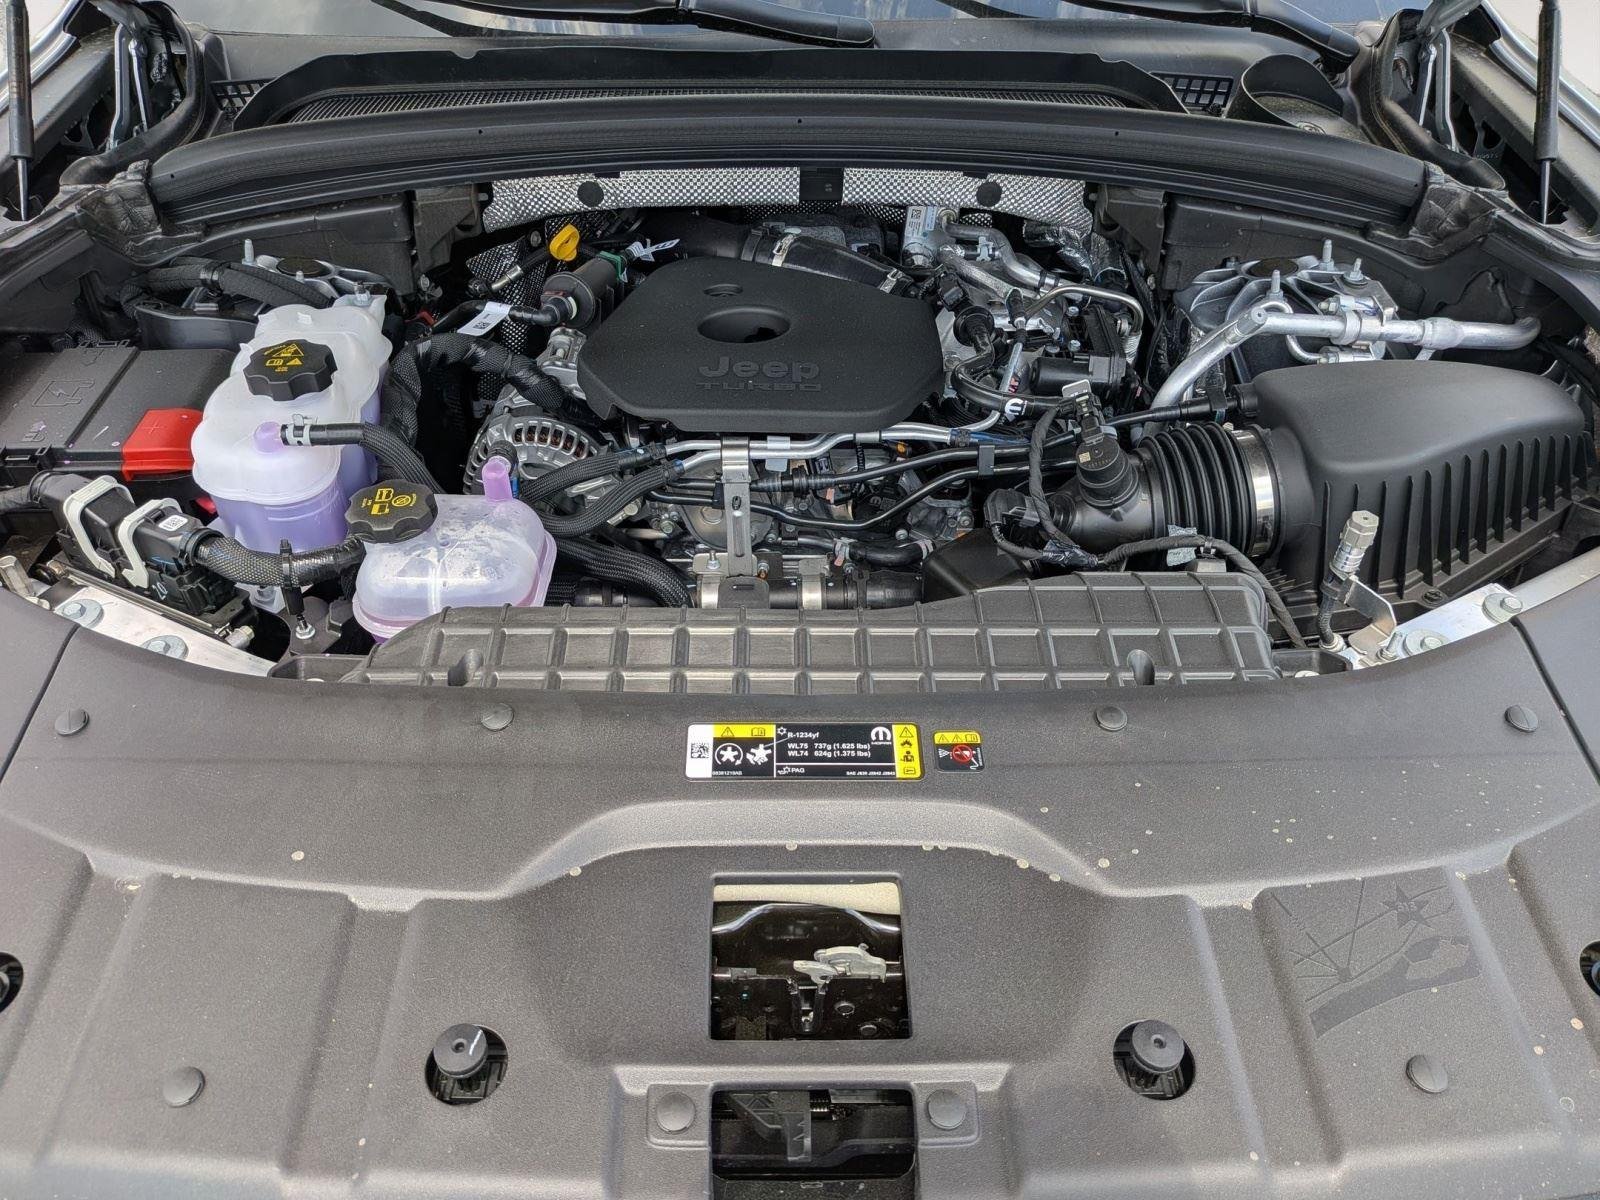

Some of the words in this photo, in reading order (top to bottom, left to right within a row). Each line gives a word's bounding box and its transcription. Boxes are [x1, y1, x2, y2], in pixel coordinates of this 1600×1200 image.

[698, 356, 820, 383] Jeep
[695, 382, 821, 392] TURBO
[833, 750, 855, 758] (1.375
[856, 750, 871, 758] lbs)
[1395, 900, 1418, 912] 313
